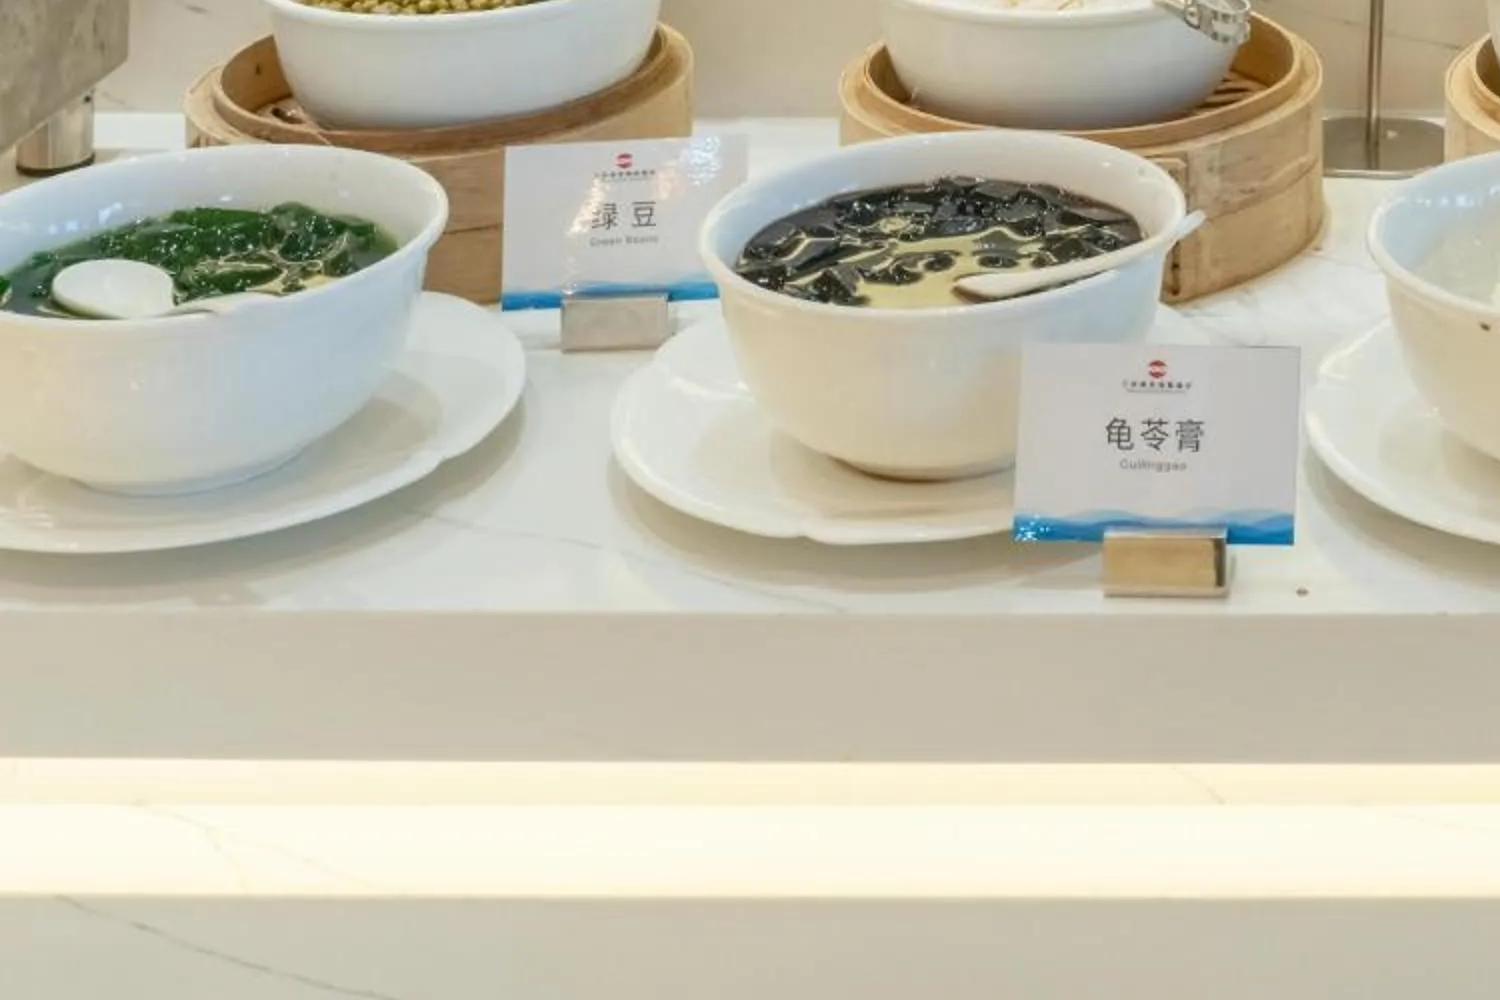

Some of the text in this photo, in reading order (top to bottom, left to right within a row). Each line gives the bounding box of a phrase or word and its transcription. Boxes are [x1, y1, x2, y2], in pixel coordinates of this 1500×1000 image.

[591, 200, 656, 230] 绿豆
[1105, 416, 1205, 452] 龟苓膏
